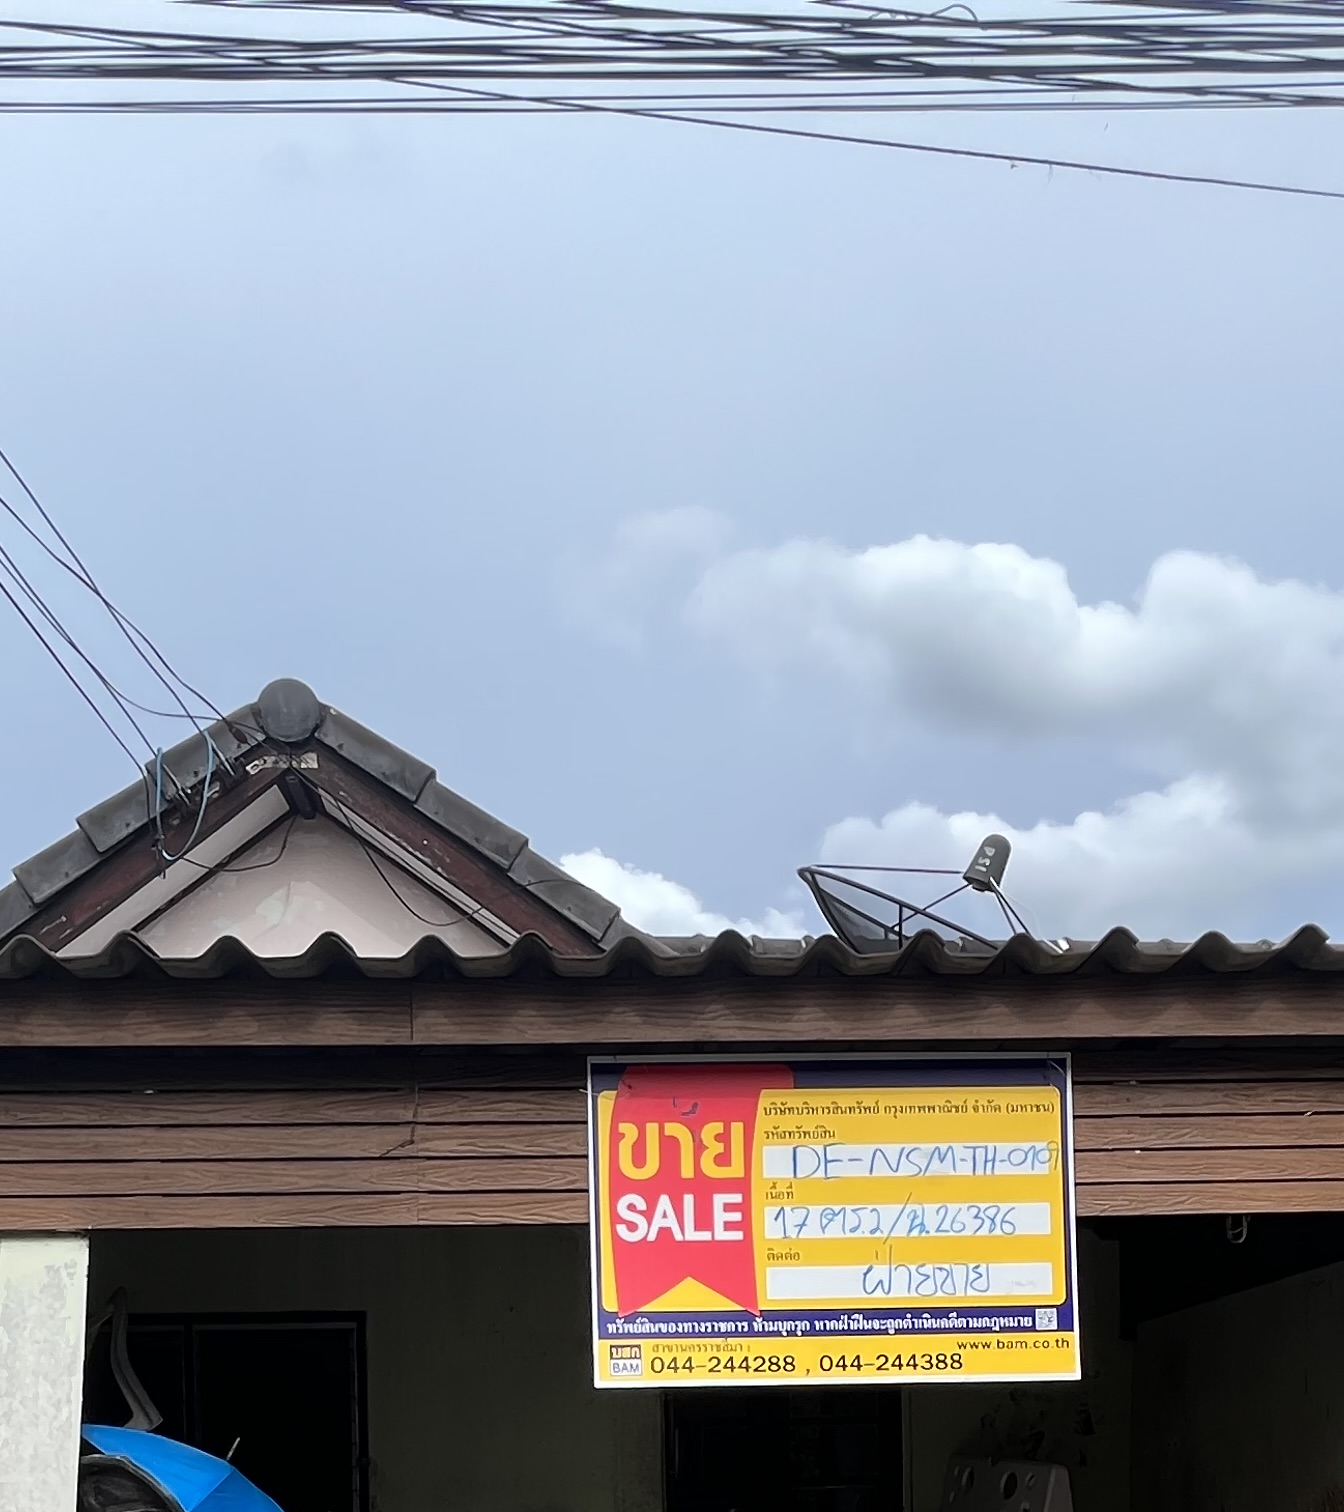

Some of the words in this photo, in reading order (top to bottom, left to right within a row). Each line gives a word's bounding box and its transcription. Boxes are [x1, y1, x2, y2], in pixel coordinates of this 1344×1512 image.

[972, 1099, 1002, 1113] จำกัด
[1006, 1101, 1055, 1114] (มหาชน)
[763, 1124, 836, 1140] รหัสทรัพย์สิน
[618, 1122, 745, 1180] ขาย
[765, 1181, 794, 1200] เนื้อที่
[615, 1193, 744, 1243] SALE
[766, 1247, 801, 1262] ติดต่อ
[606, 1317, 749, 1334] ทรัพย์สินของทางราชการ
[752, 1315, 810, 1337] ห้ามบุกรุก
[956, 1337, 1070, 1350] www.bam.co.th
[611, 1346, 641, 1358] บสก
[612, 1362, 640, 1374] BAM
[650, 1355, 796, 1374] 044-244288
[819, 1353, 963, 1373] 044-244388
